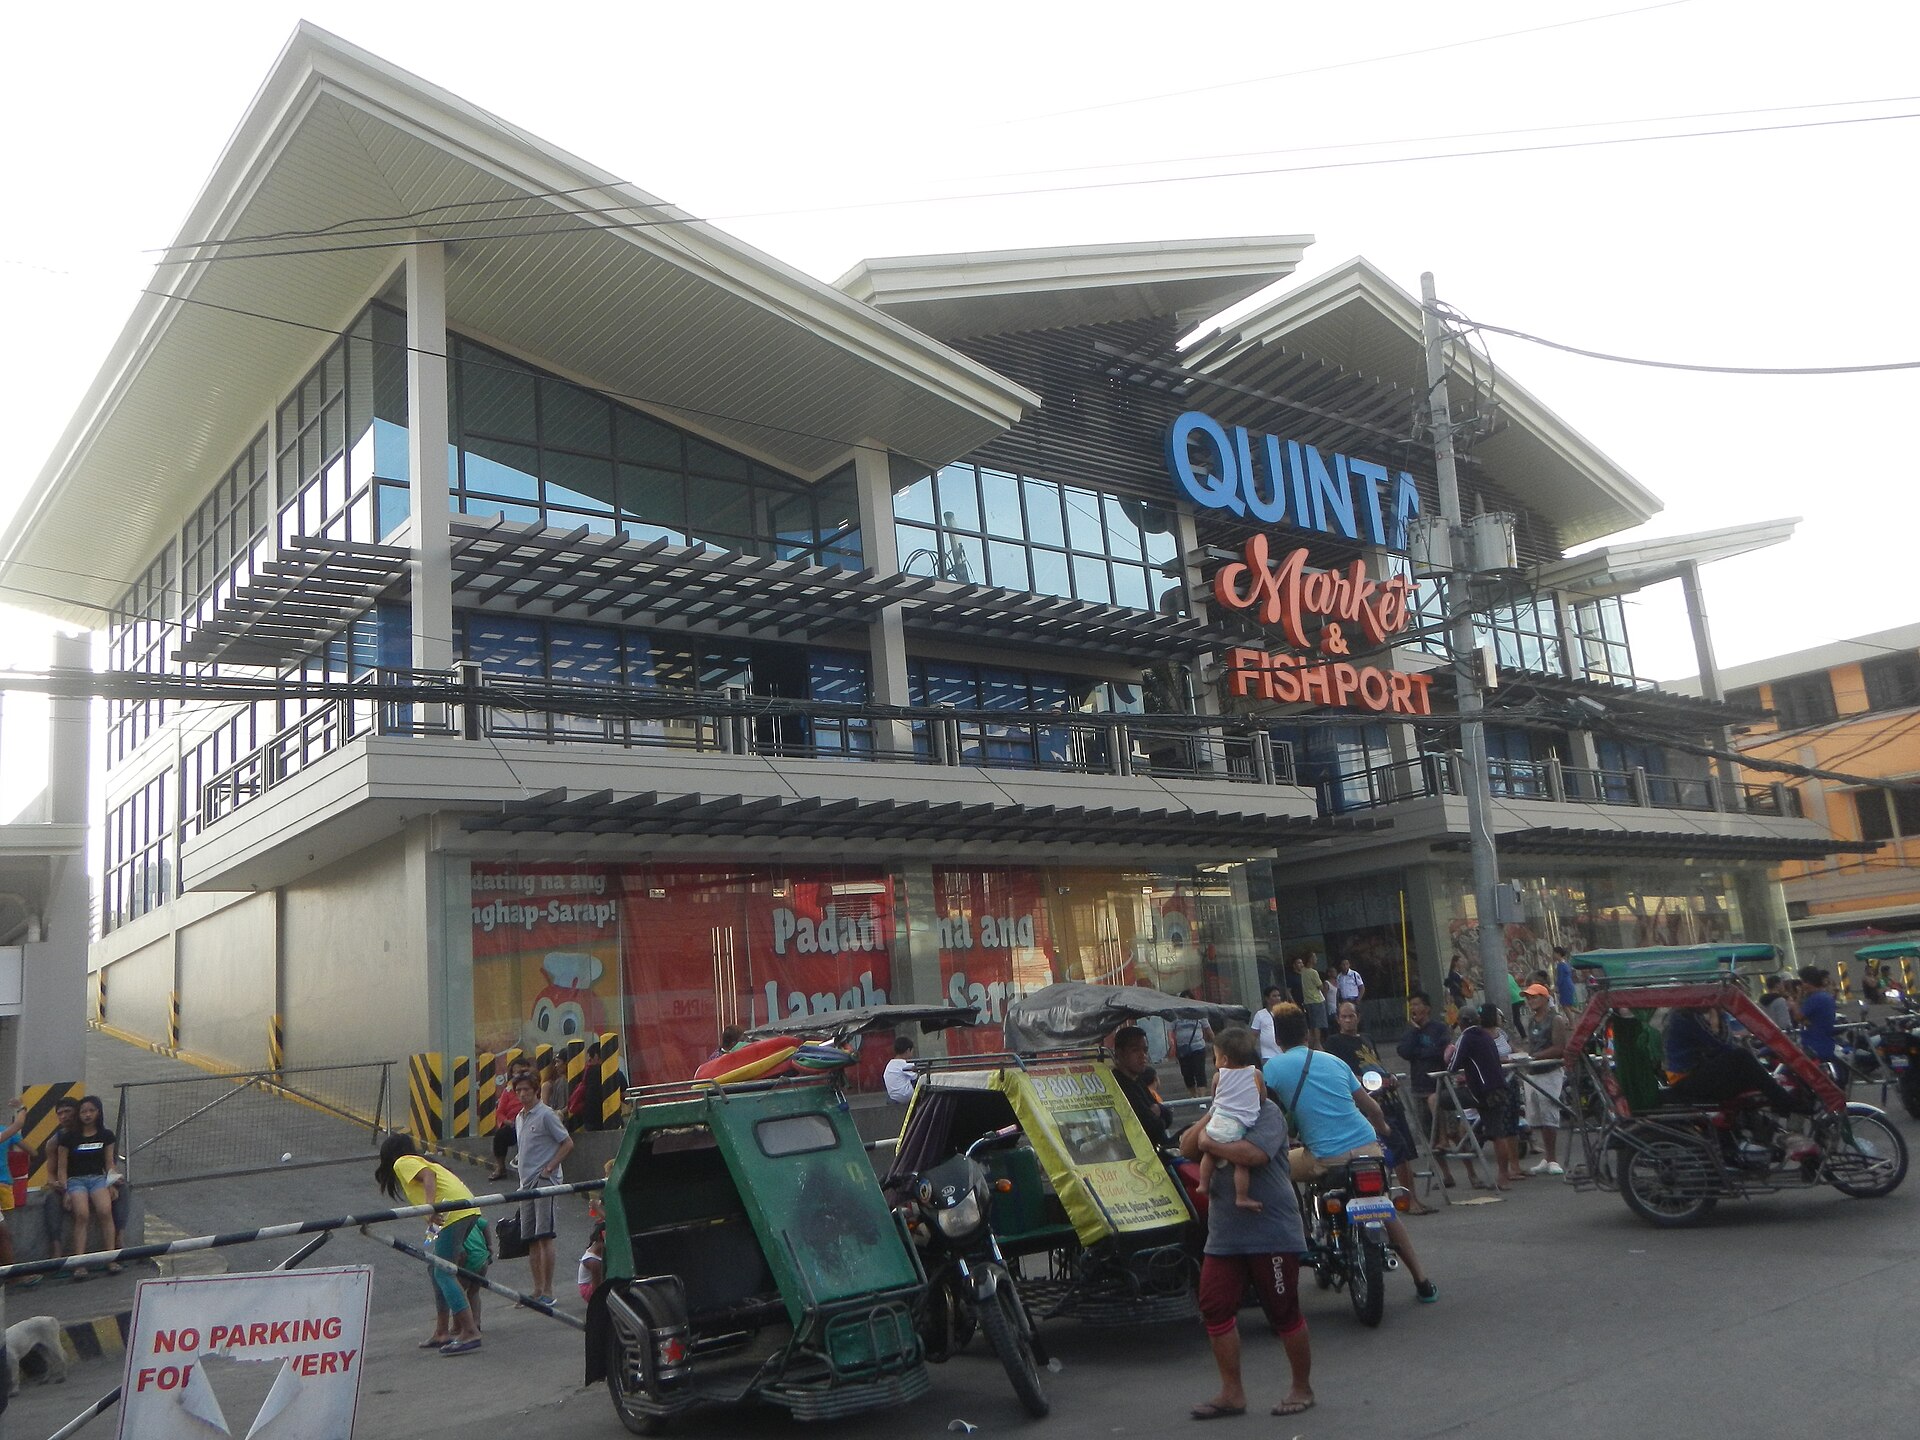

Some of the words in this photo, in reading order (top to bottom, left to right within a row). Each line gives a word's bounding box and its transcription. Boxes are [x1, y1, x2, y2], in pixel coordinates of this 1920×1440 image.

[1168, 411, 1420, 551] QUINTA
[1216, 533, 1421, 647] Market
[1321, 623, 1349, 655] &
[541, 875, 565, 890] na
[570, 874, 606, 895] ang
[980, 913, 1035, 961] ang
[1046, 1073, 1106, 1098] 800.00
[154, 1328, 200, 1353] NO
[209, 1316, 342, 1349] PARKING
